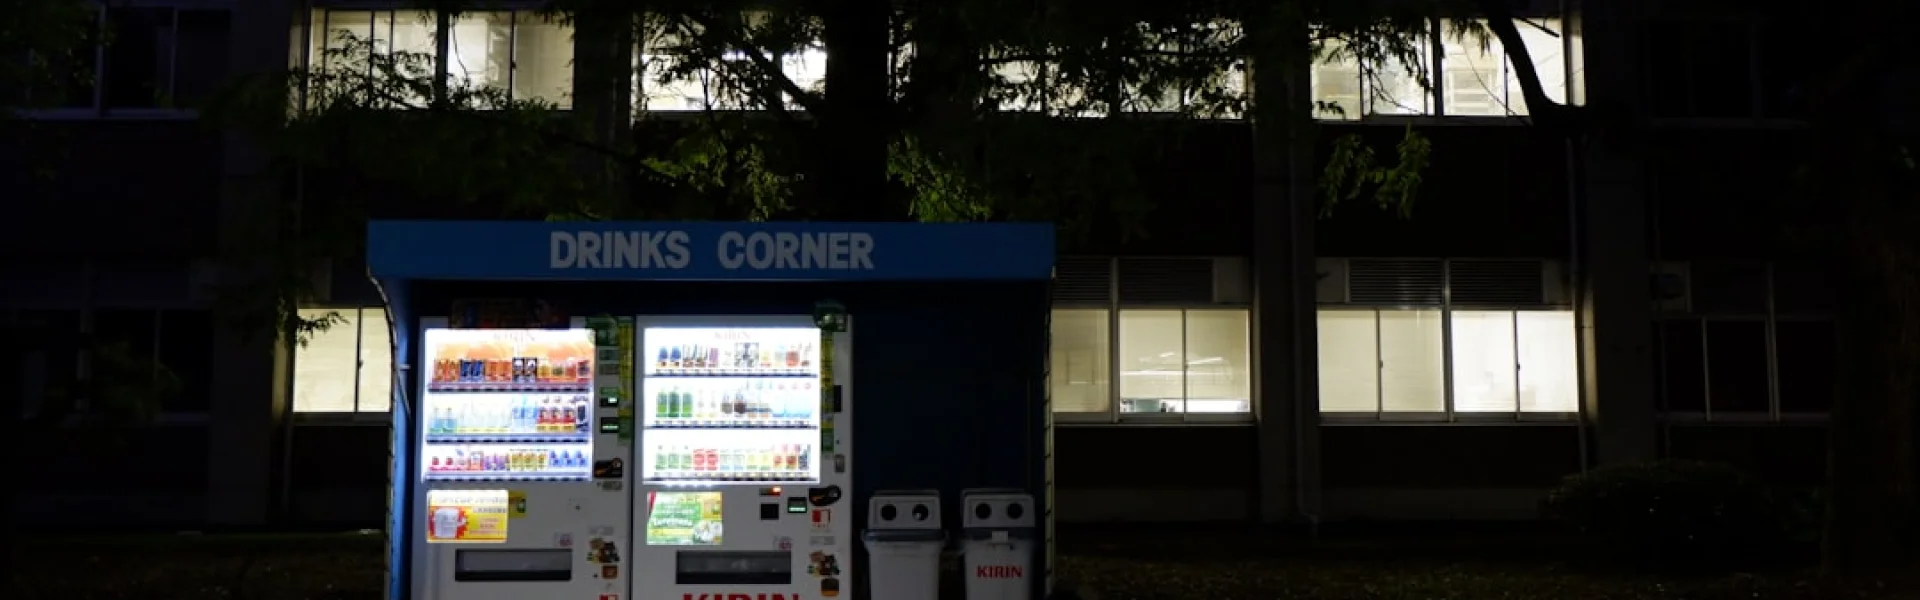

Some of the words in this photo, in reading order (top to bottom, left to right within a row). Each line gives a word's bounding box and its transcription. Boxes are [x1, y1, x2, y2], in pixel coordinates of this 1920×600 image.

[550, 231, 691, 270] DRINKS
[717, 231, 875, 270] CORNER
[976, 564, 1024, 579] KIRIN
